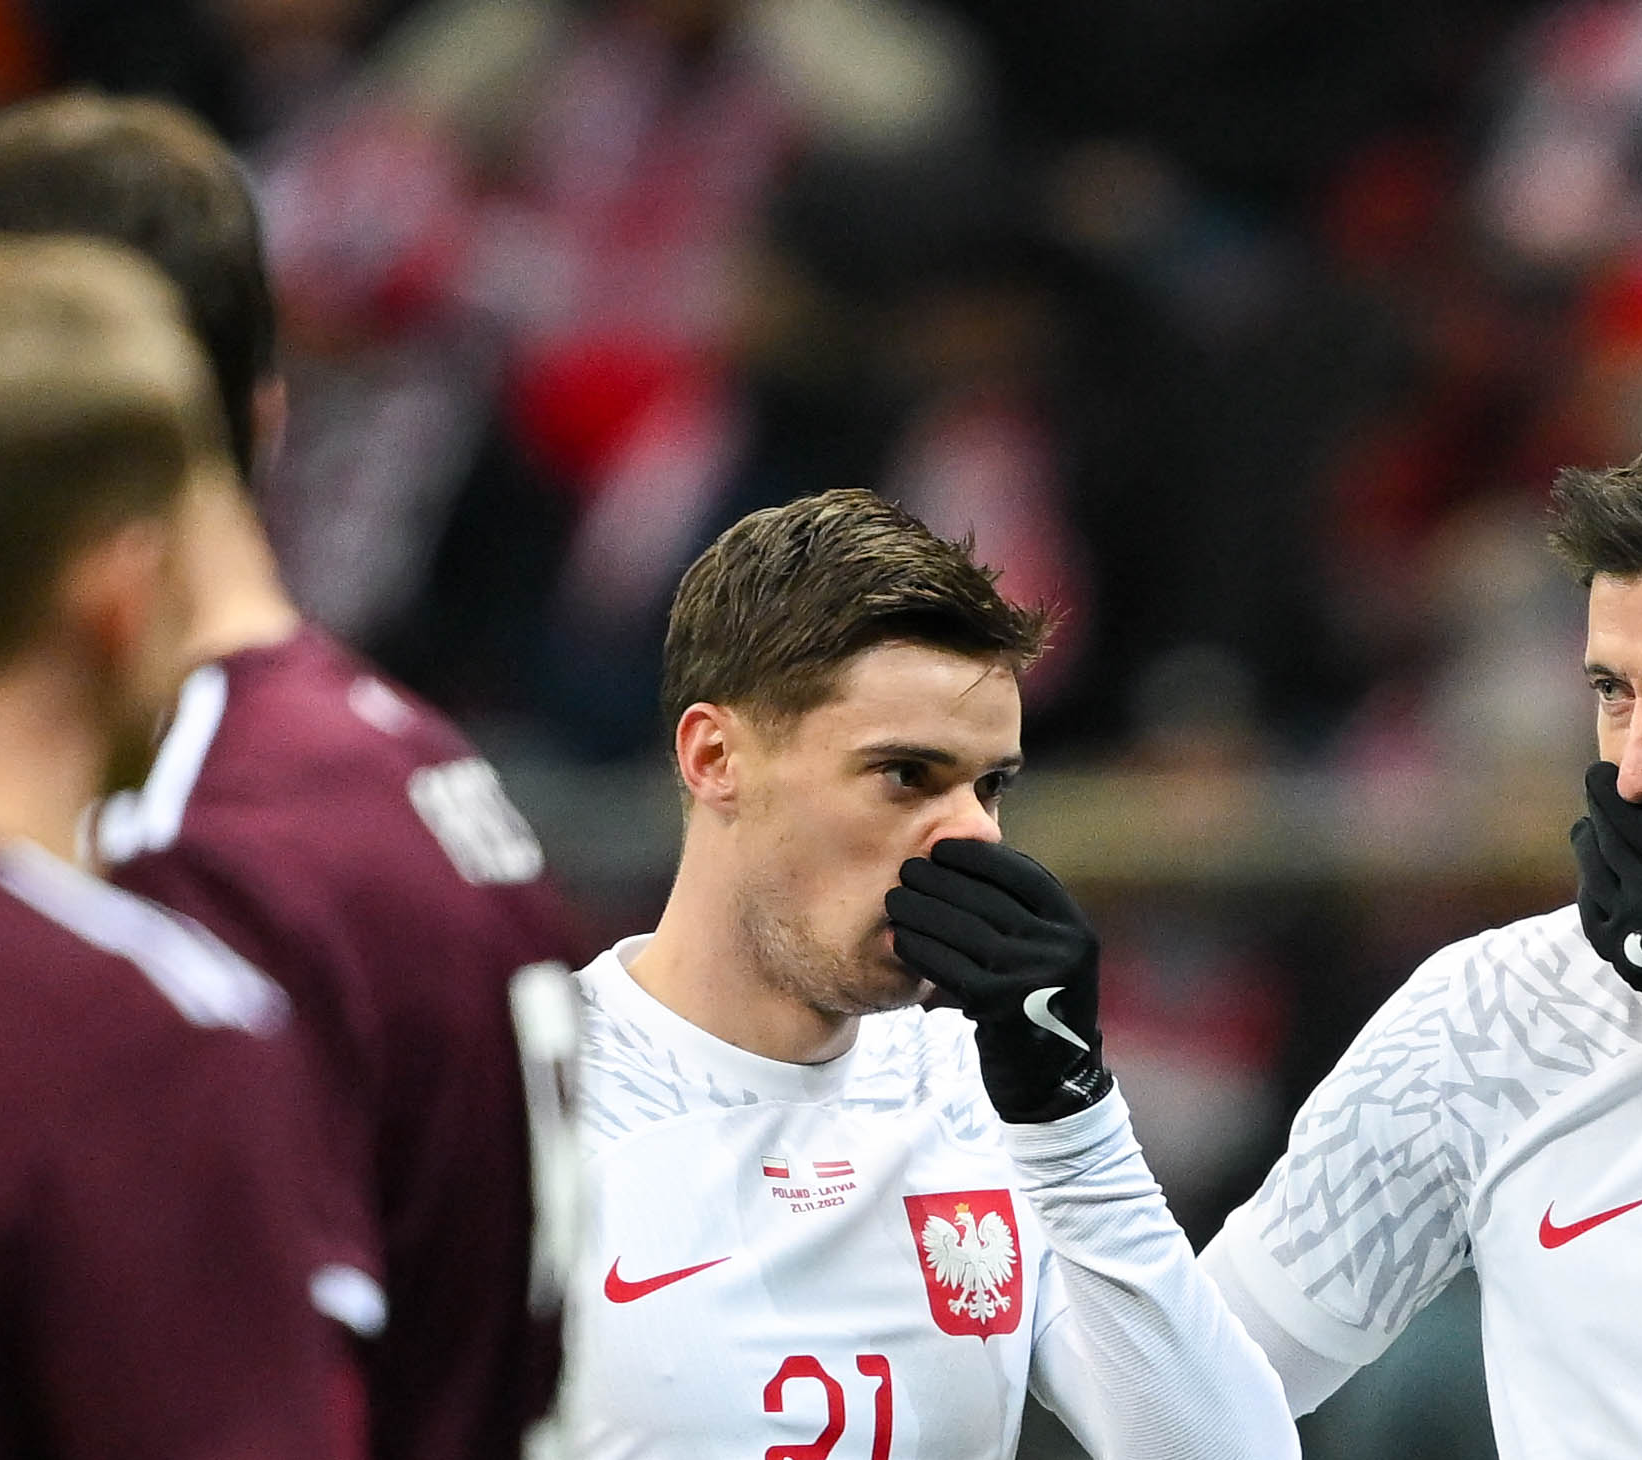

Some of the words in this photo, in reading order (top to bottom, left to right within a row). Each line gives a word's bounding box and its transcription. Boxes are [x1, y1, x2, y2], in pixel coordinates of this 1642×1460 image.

[772, 1187, 810, 1199] POLAND
[819, 1182, 857, 1196] LATVIA
[790, 1197, 845, 1213] 21.11.2023
